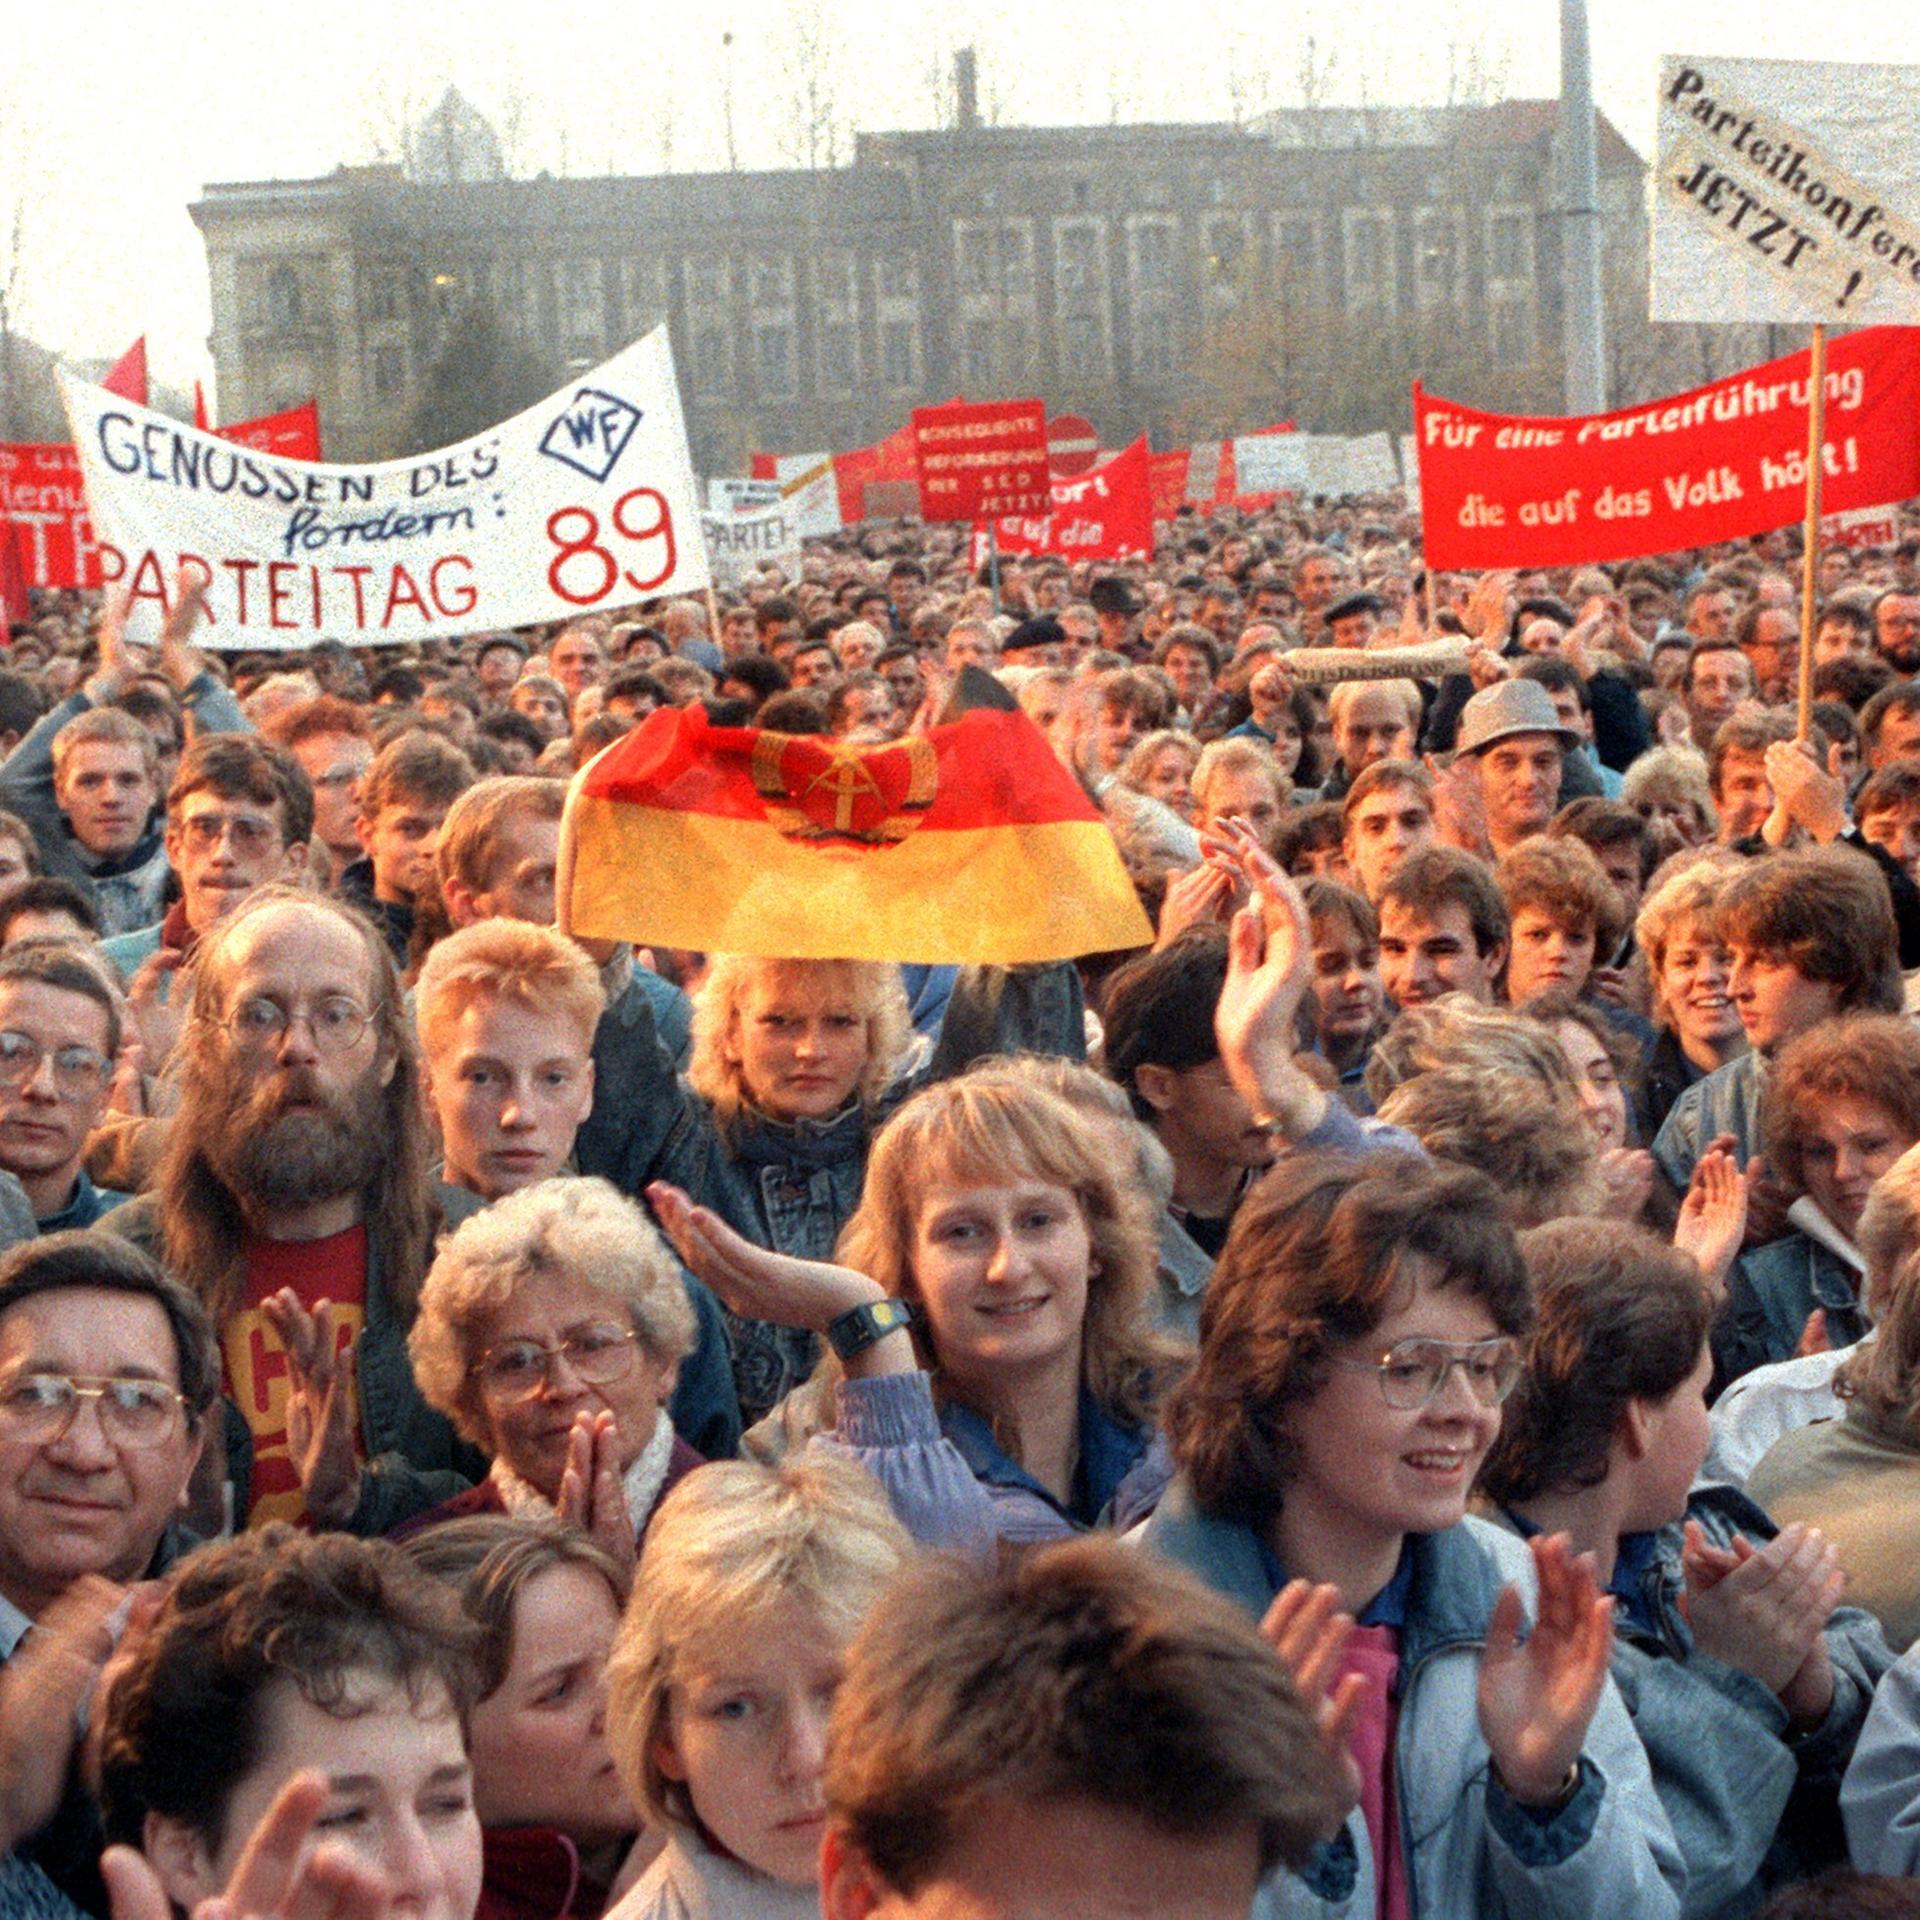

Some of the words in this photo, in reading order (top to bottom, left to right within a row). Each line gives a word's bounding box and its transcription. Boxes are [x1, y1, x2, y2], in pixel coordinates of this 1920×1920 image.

[1677, 163, 1819, 269] JETZT
[410, 438, 500, 497] DES
[564, 405, 620, 455] WF
[1425, 412, 1481, 448] Für
[1458, 493, 1505, 527] die
[1518, 488, 1581, 526] auf
[1593, 485, 1652, 520] das
[1663, 466, 1744, 511] Volk
[1760, 436, 1859, 492] höt!
[98, 543, 478, 630] PARTEITAG
[546, 486, 677, 606] 89
